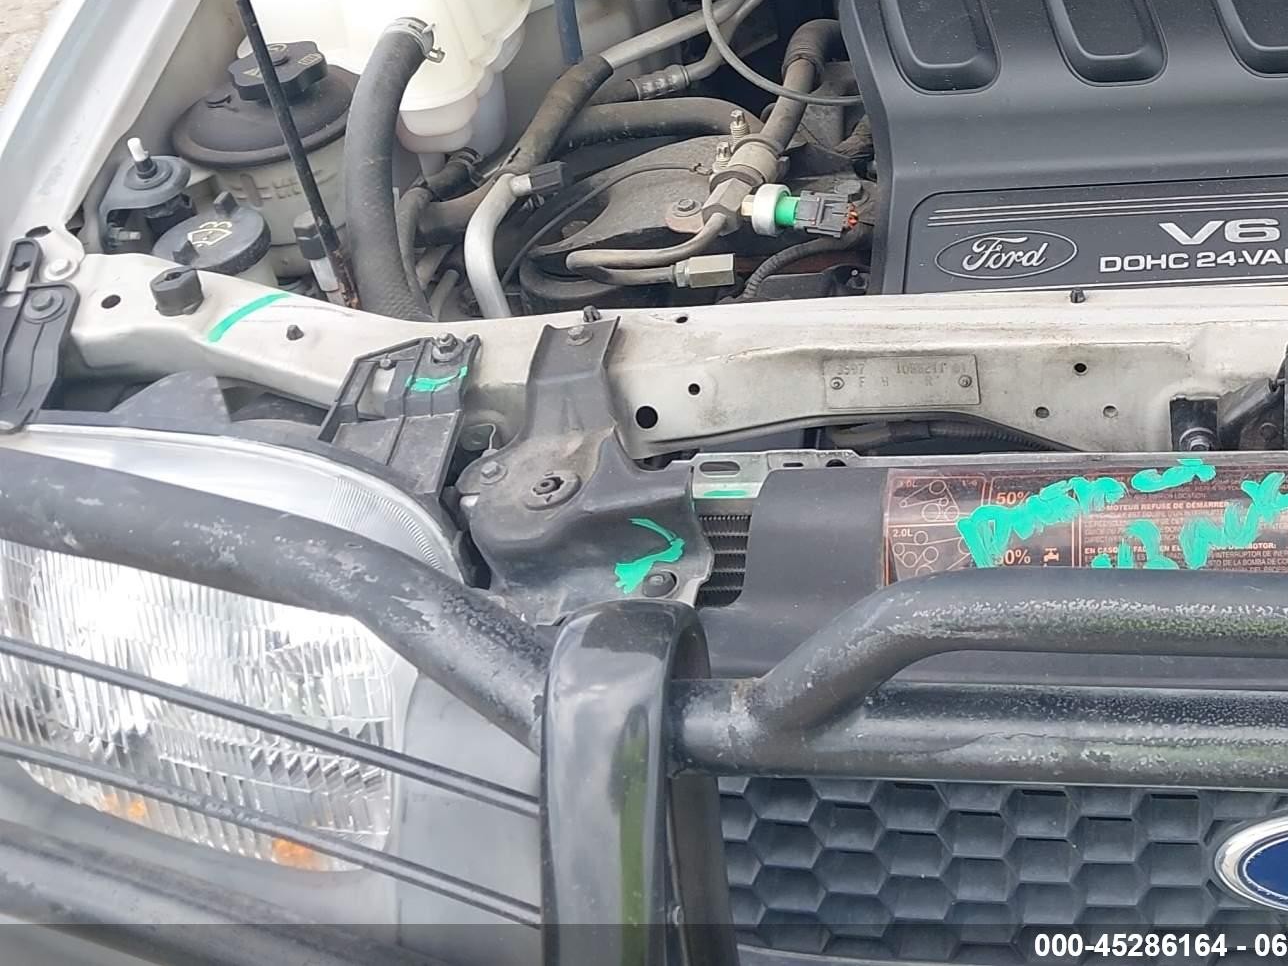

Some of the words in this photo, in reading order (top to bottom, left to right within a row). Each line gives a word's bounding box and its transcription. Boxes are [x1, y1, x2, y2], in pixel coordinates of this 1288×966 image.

[1158, 218, 1280, 245] V6
[962, 236, 1049, 271] Ford
[1099, 252, 1189, 272] DOHC
[1141, 503, 1171, 511] REFUSE
[893, 528, 913, 538] 2.0L
